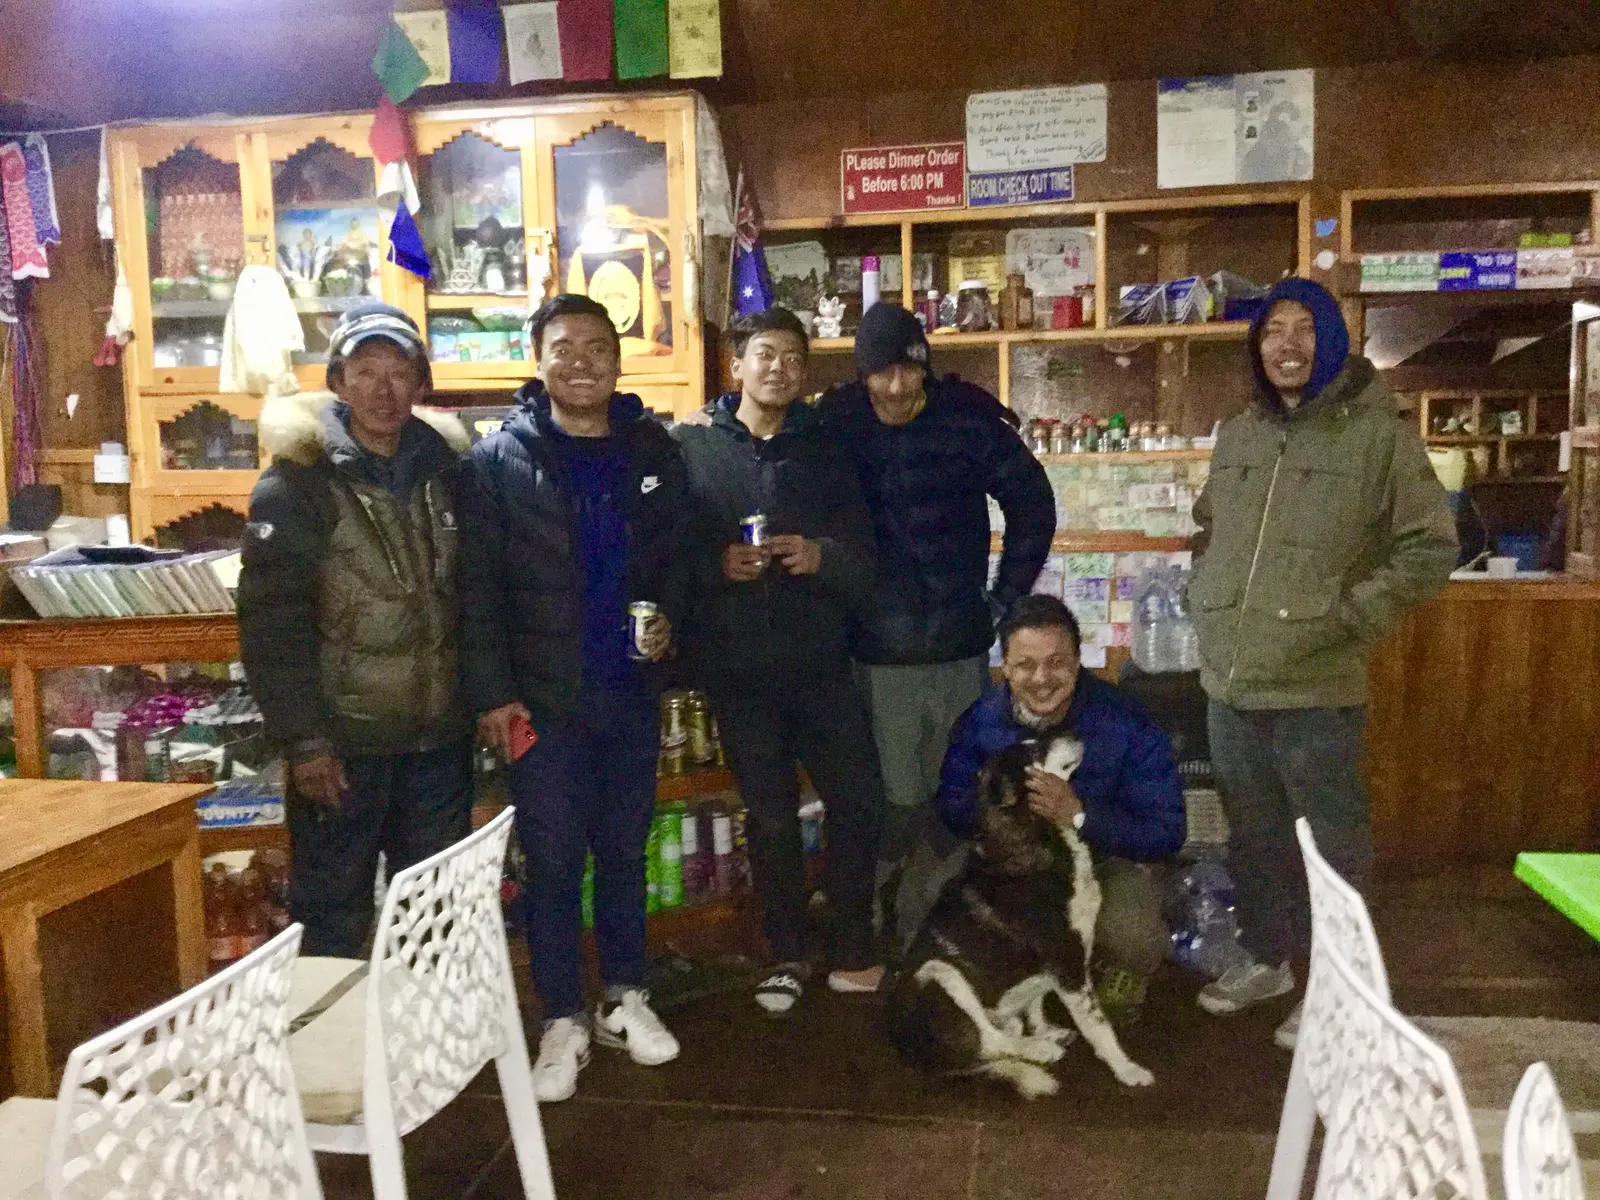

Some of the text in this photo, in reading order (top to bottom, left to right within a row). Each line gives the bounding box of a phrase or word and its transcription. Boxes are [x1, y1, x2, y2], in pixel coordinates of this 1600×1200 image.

[888, 151, 925, 169] Dinner
[927, 148, 960, 166] Order
[862, 172, 944, 193] Before 6:00 PM
[970, 171, 1071, 198] ROOM CHECK OUT TIME
[926, 194, 956, 206] Thanks
[1476, 254, 1514, 267] NO TAP
[1363, 263, 1434, 276] CARD ACCEPTED
[1478, 274, 1511, 287] WATER
